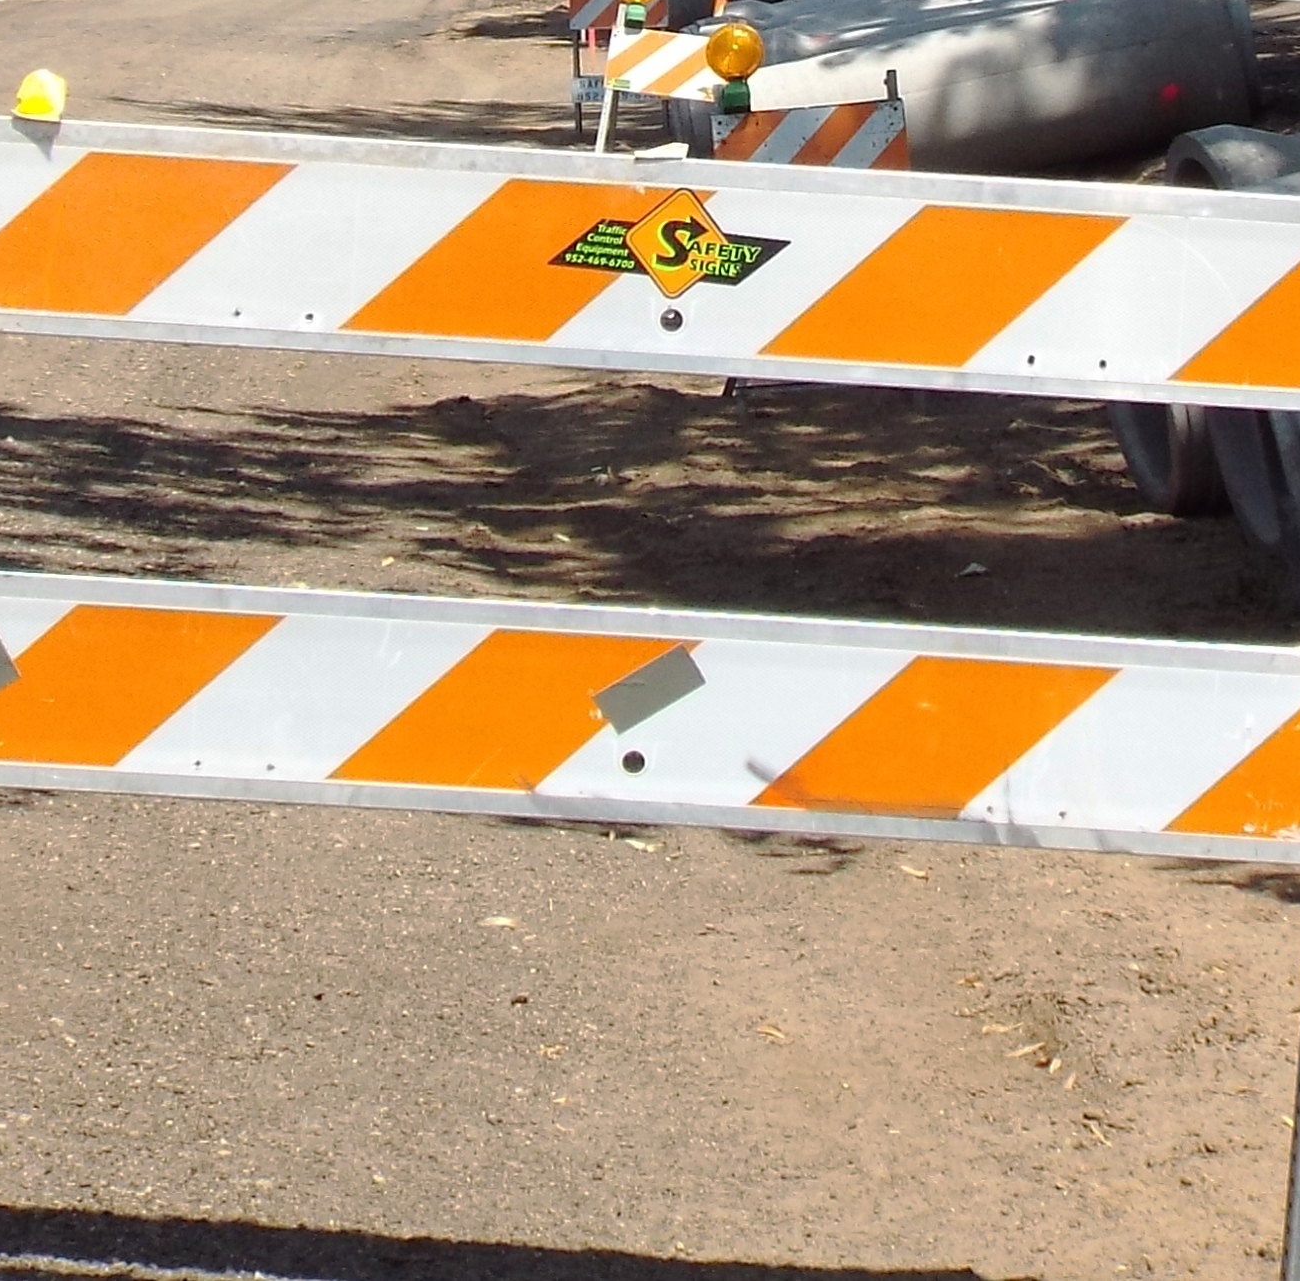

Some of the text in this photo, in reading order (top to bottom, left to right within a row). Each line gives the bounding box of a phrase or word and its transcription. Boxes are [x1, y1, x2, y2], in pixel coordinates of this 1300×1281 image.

[598, 224, 628, 235] Traffic
[587, 233, 623, 244] Control
[652, 216, 762, 271] SAFETY
[576, 243, 629, 256] Equipment
[565, 253, 635, 269] 952-469-6700
[689, 259, 742, 277] SIGNS
